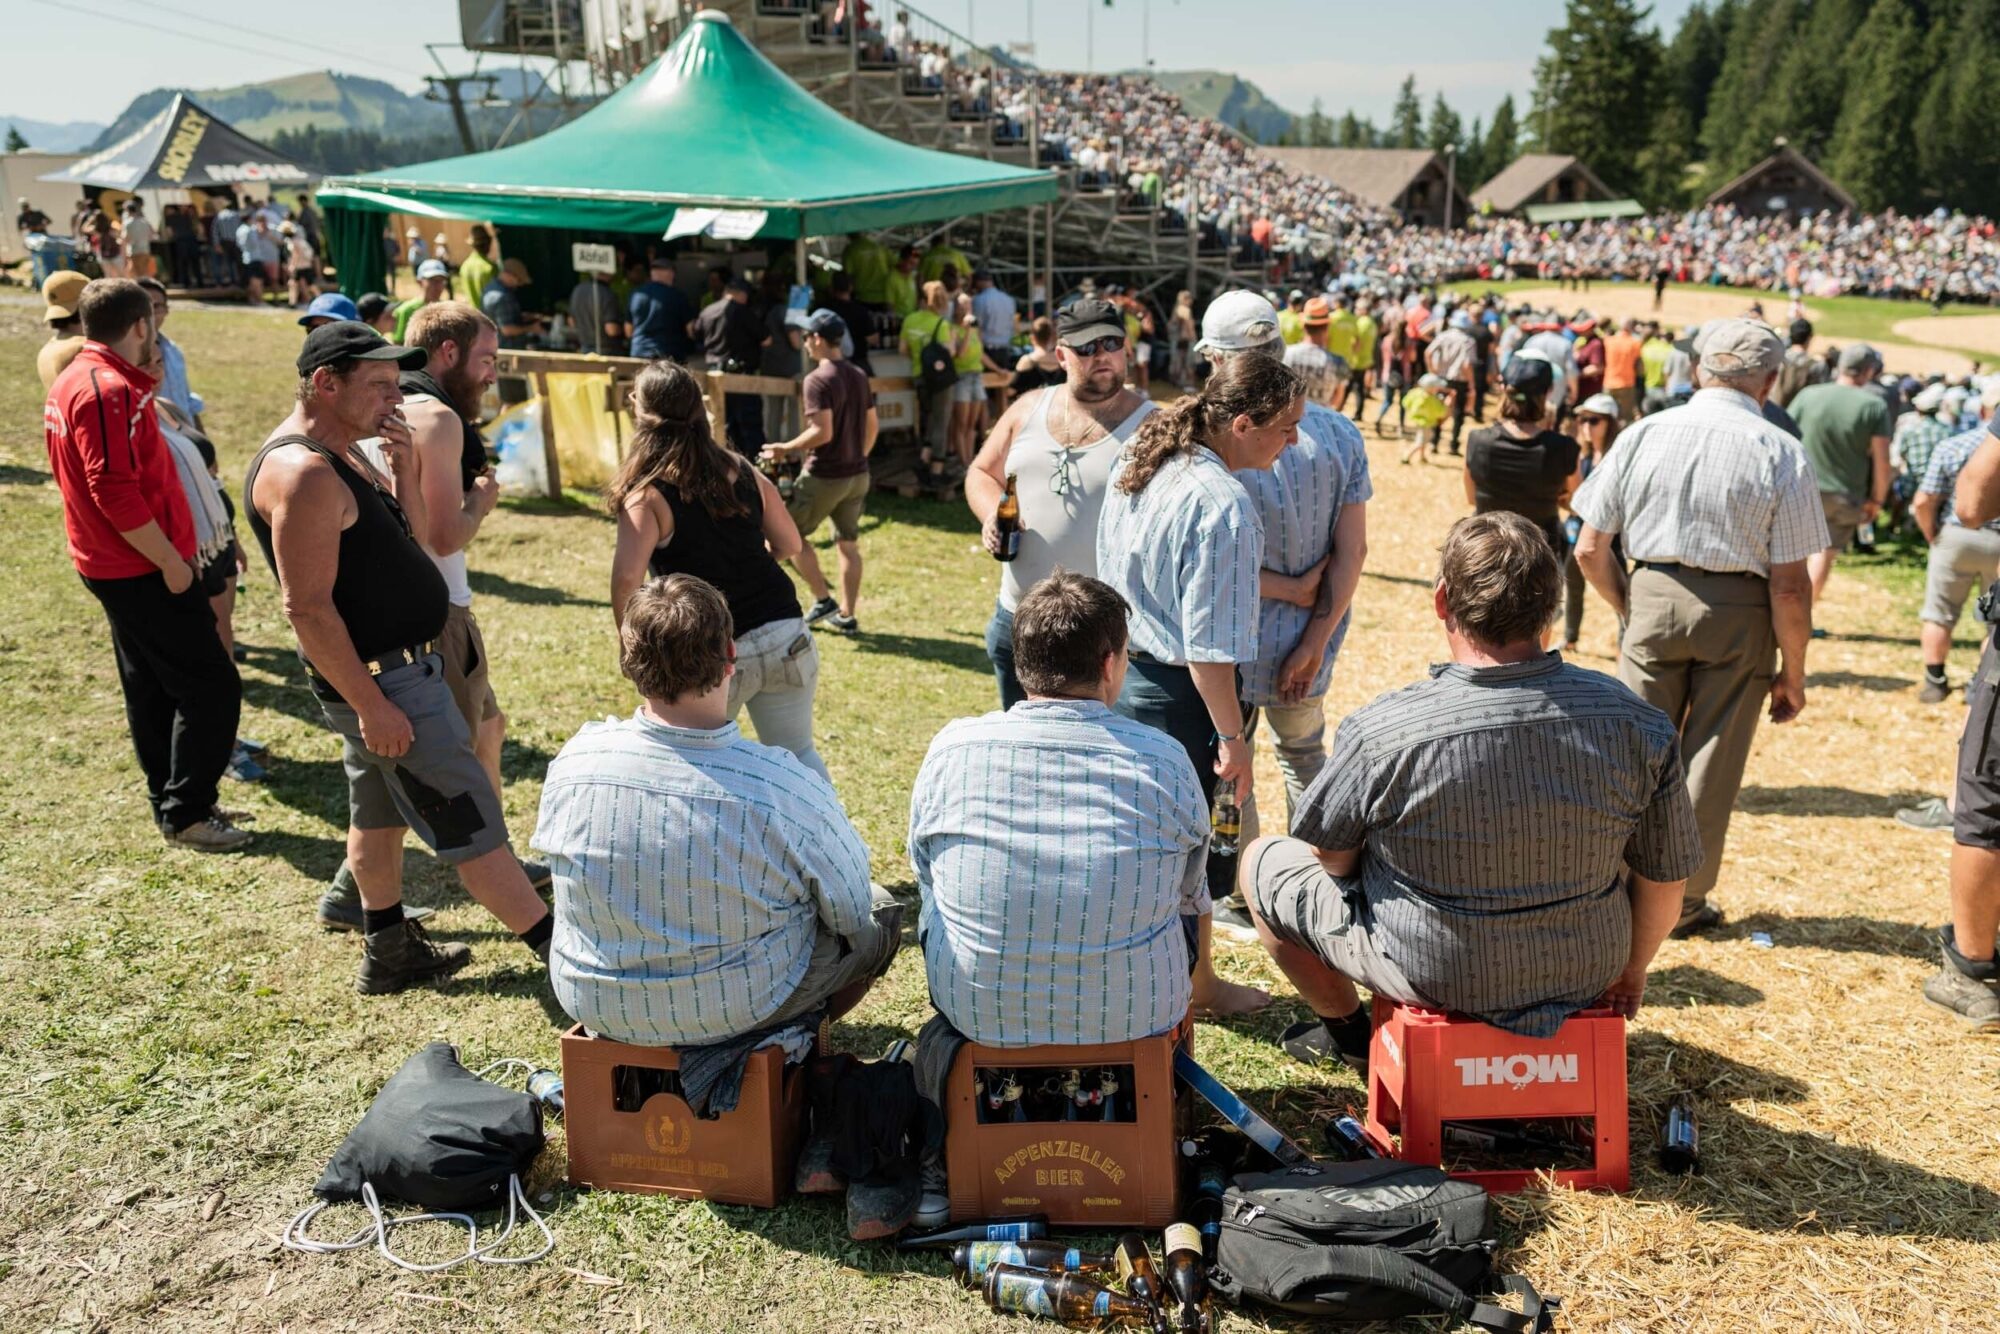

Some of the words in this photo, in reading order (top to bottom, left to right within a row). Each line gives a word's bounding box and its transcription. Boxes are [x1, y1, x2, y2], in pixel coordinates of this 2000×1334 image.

[578, 250, 610, 265] Abfall
[994, 1140, 1126, 1185] APPENZELLER
[1036, 1169, 1085, 1186] BIER
